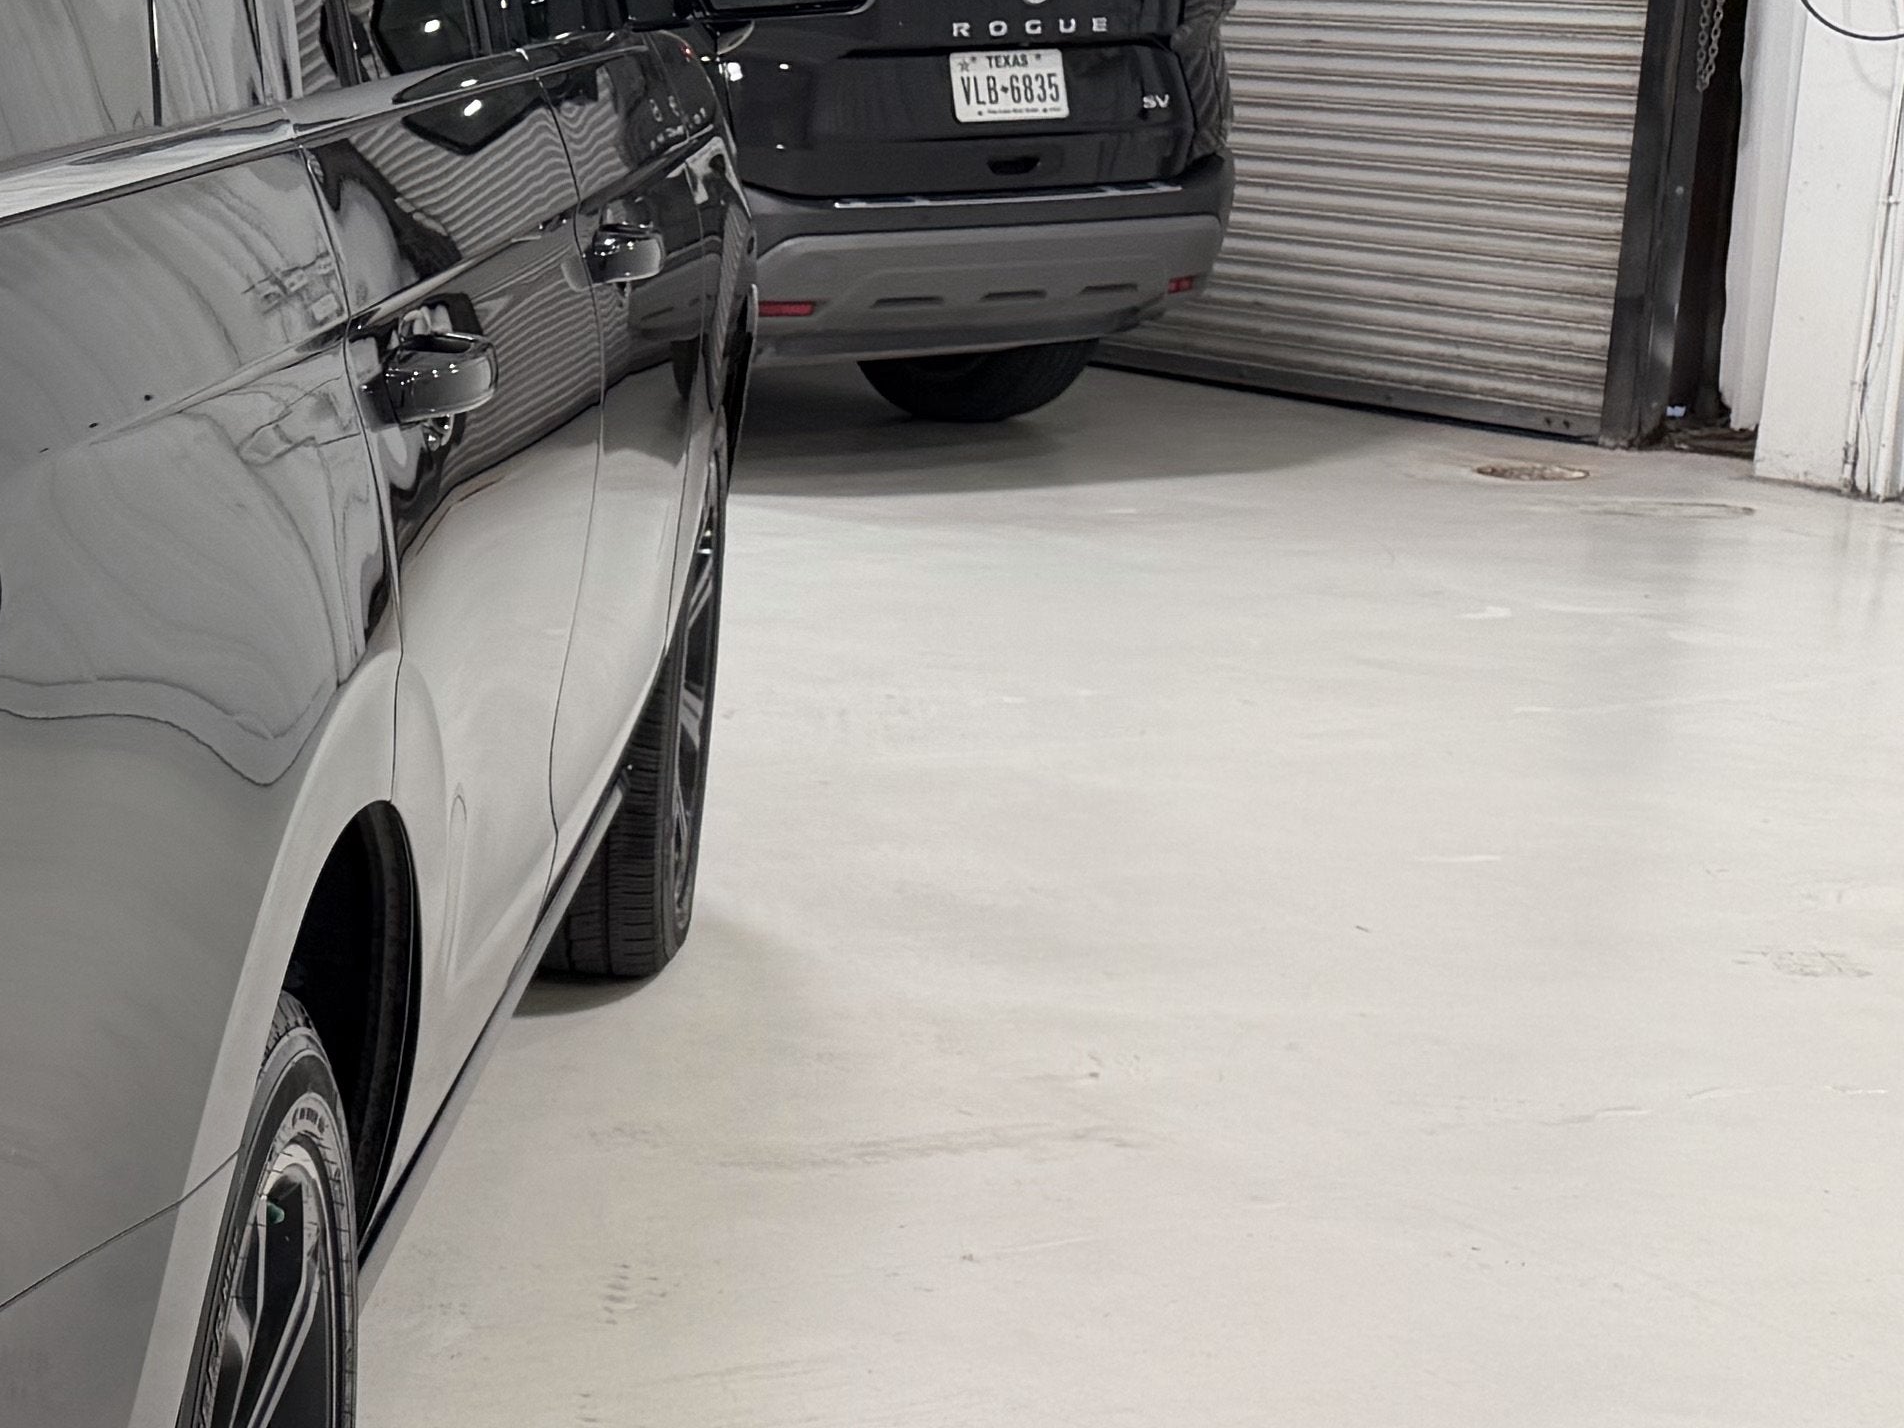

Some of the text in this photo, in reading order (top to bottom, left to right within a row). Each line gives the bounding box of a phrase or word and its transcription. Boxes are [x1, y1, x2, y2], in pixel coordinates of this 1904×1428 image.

[952, 16, 1108, 38] ROGUE
[986, 53, 1029, 69] TEXAS
[1142, 93, 1170, 109] SV
